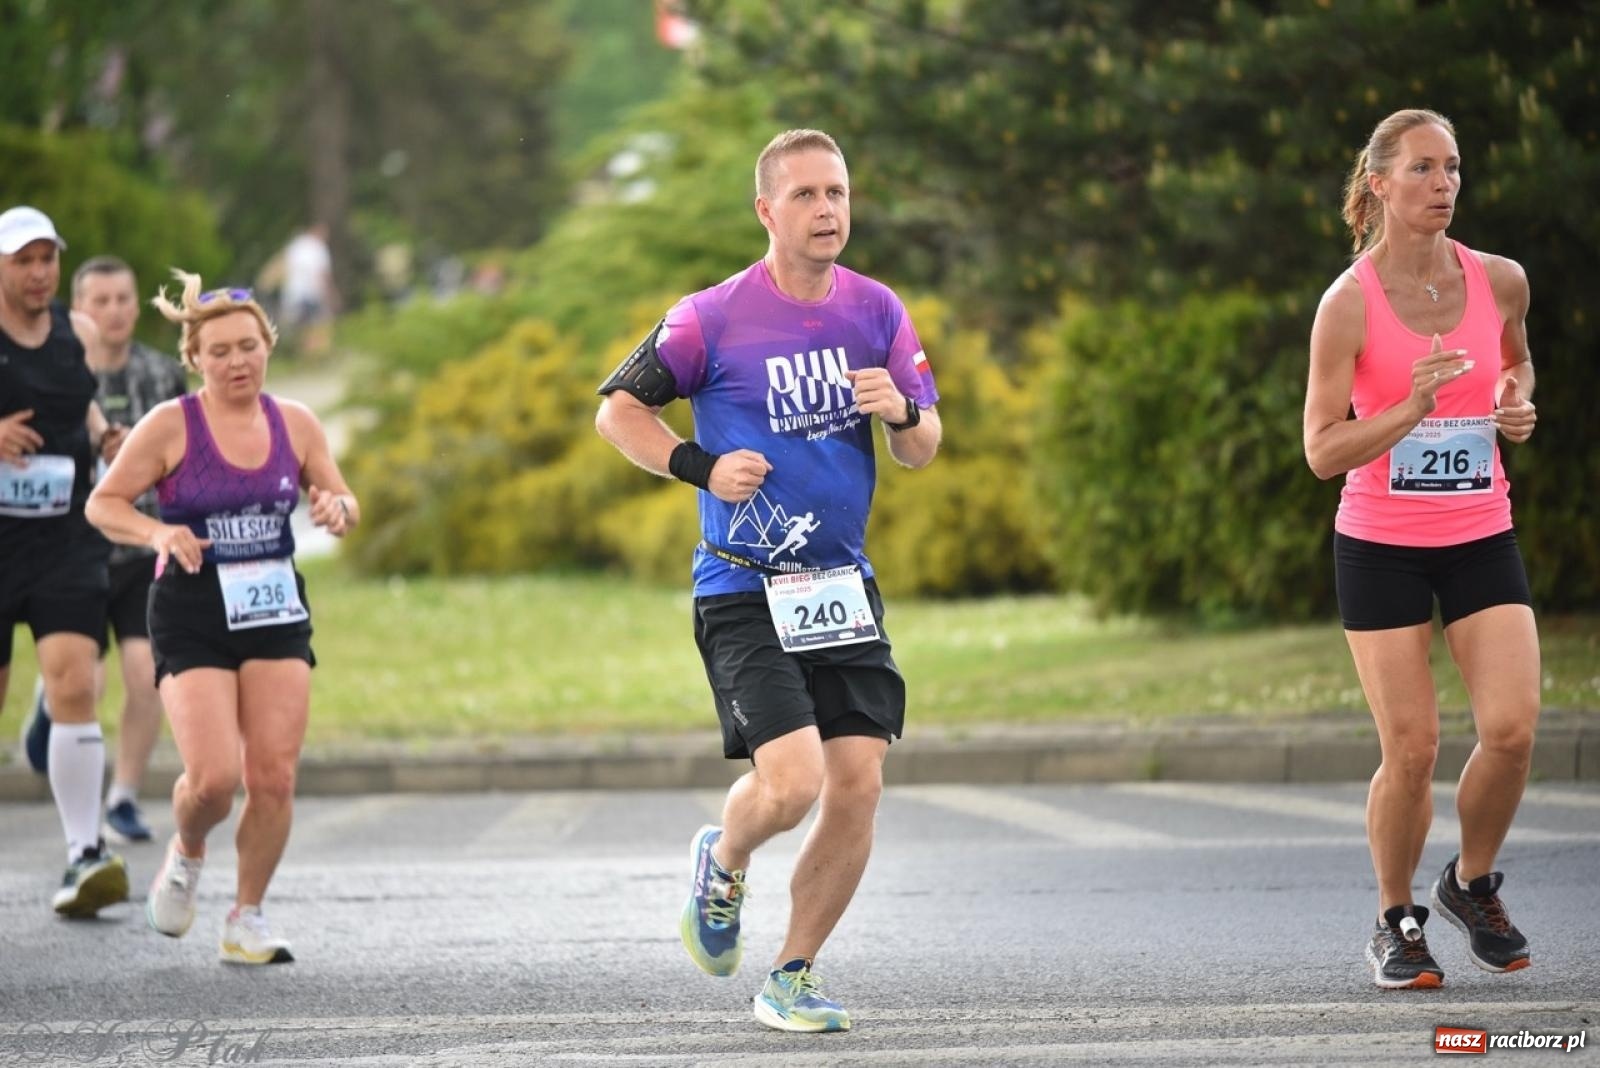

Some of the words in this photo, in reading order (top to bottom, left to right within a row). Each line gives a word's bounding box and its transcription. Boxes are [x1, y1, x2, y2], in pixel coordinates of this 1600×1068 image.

[765, 347, 855, 418] RUN
[1421, 420, 1442, 428] BIEG
[1444, 419, 1459, 428] BEZ
[1421, 449, 1470, 475] 216
[11, 480, 50, 499] 154
[790, 575, 811, 583] BIEG
[812, 572, 826, 581] BEZ
[826, 567, 854, 579] GRANIC
[248, 583, 285, 607] 236
[794, 600, 848, 630] 240
